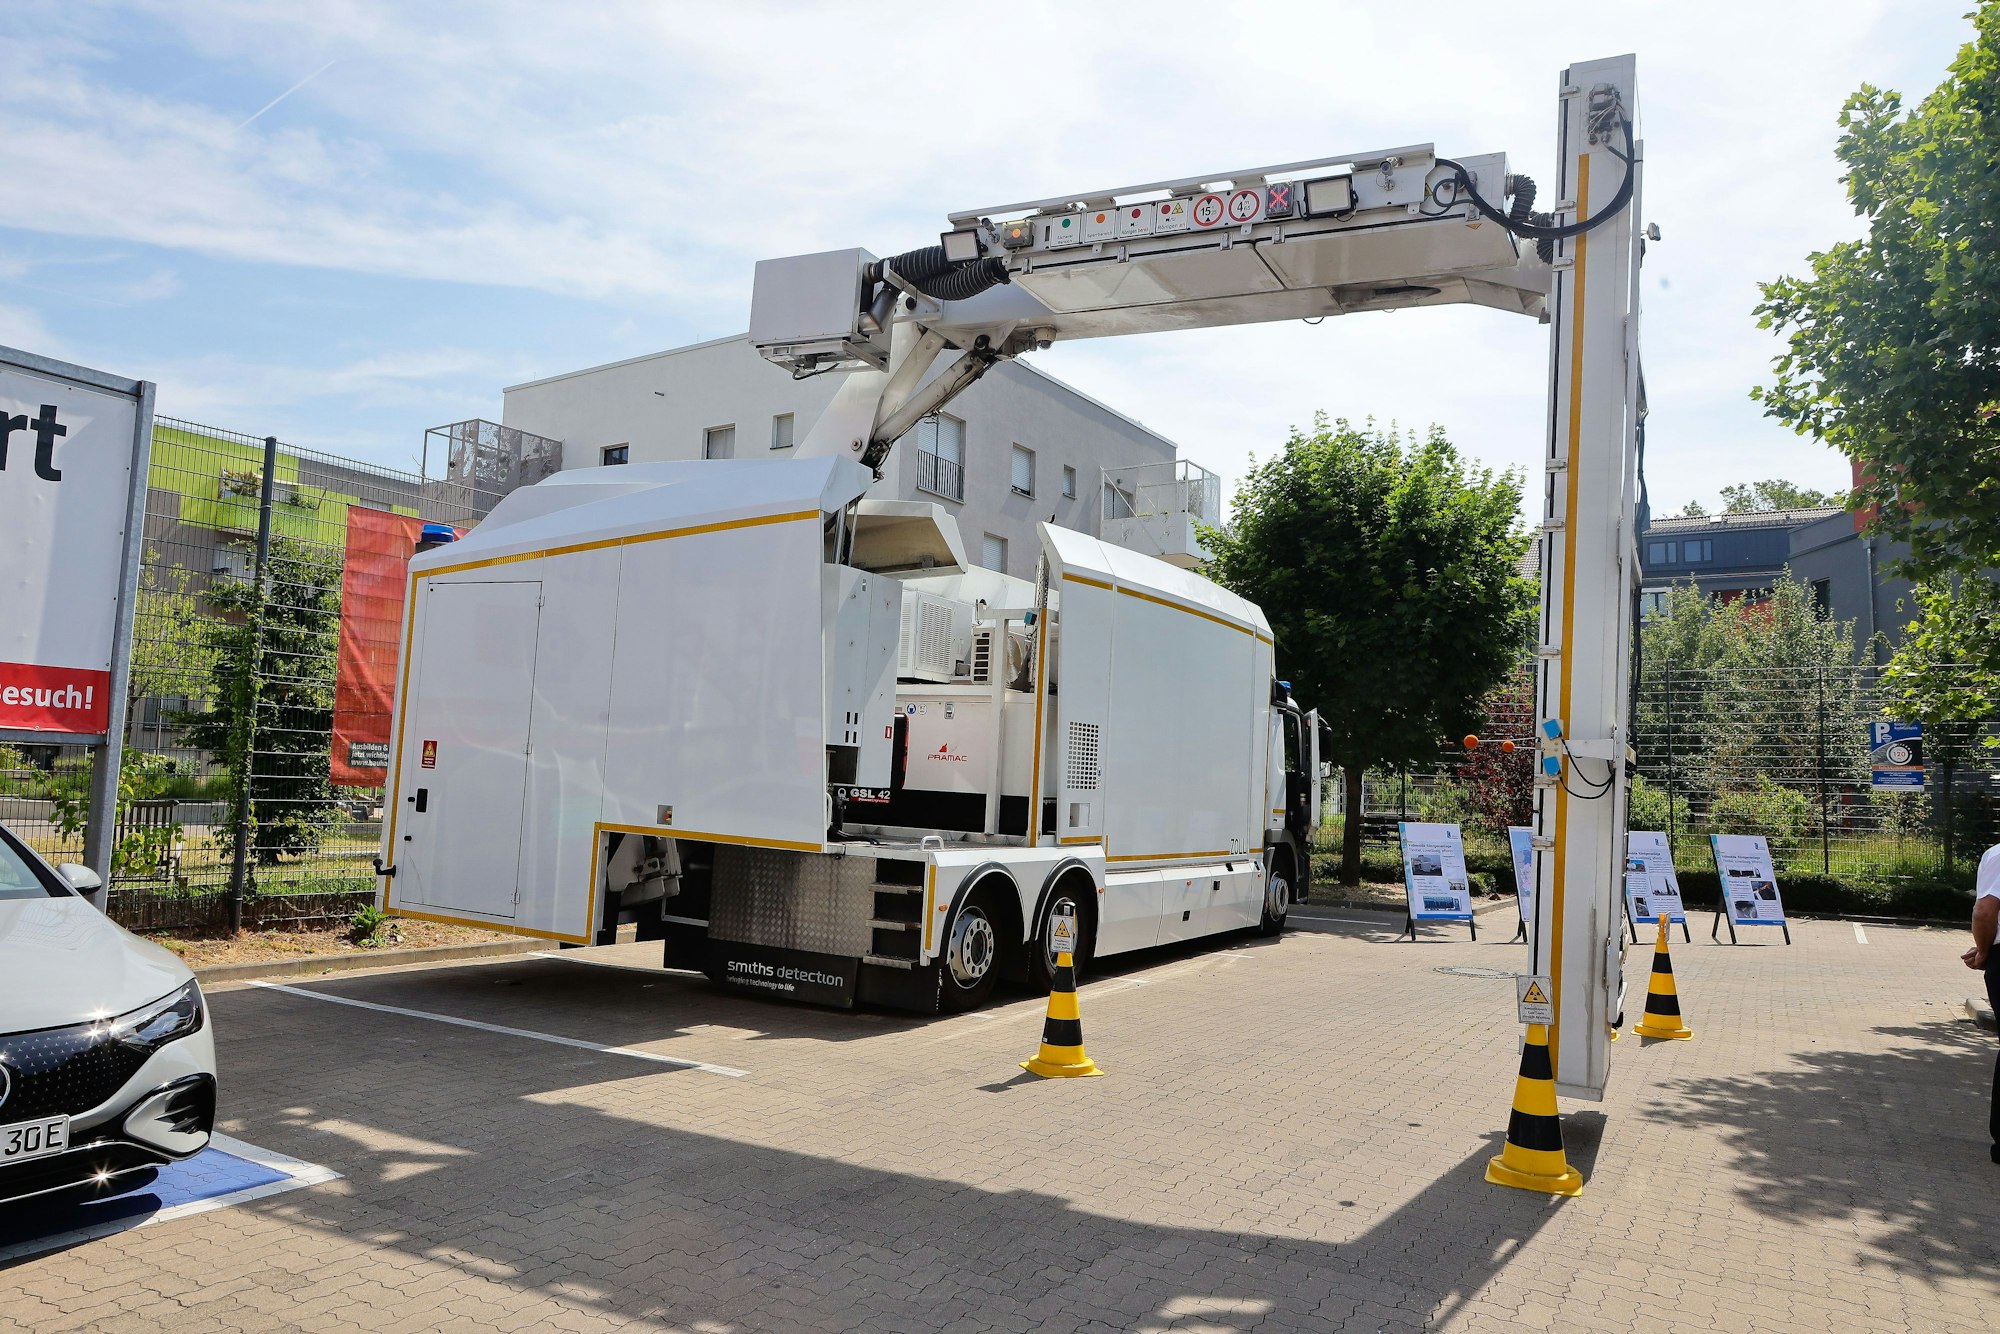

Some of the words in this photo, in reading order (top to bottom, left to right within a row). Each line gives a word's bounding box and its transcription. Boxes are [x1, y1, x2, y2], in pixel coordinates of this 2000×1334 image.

[1200, 206, 1211, 216] 15
[1237, 201, 1243, 212] 4
[0, 684, 93, 710] esuch!
[1875, 722, 1890, 744] P
[352, 742, 382, 751] Ausbilden
[383, 744, 389, 752] &
[366, 751, 389, 760] wichtig
[850, 788, 875, 798] GSL
[878, 790, 890, 800] 42
[1230, 838, 1247, 855] ZOLL
[727, 960, 774, 977] smiths
[776, 966, 844, 987] detection
[749, 978, 777, 990] technology
[5, 1121, 63, 1156] 30E
